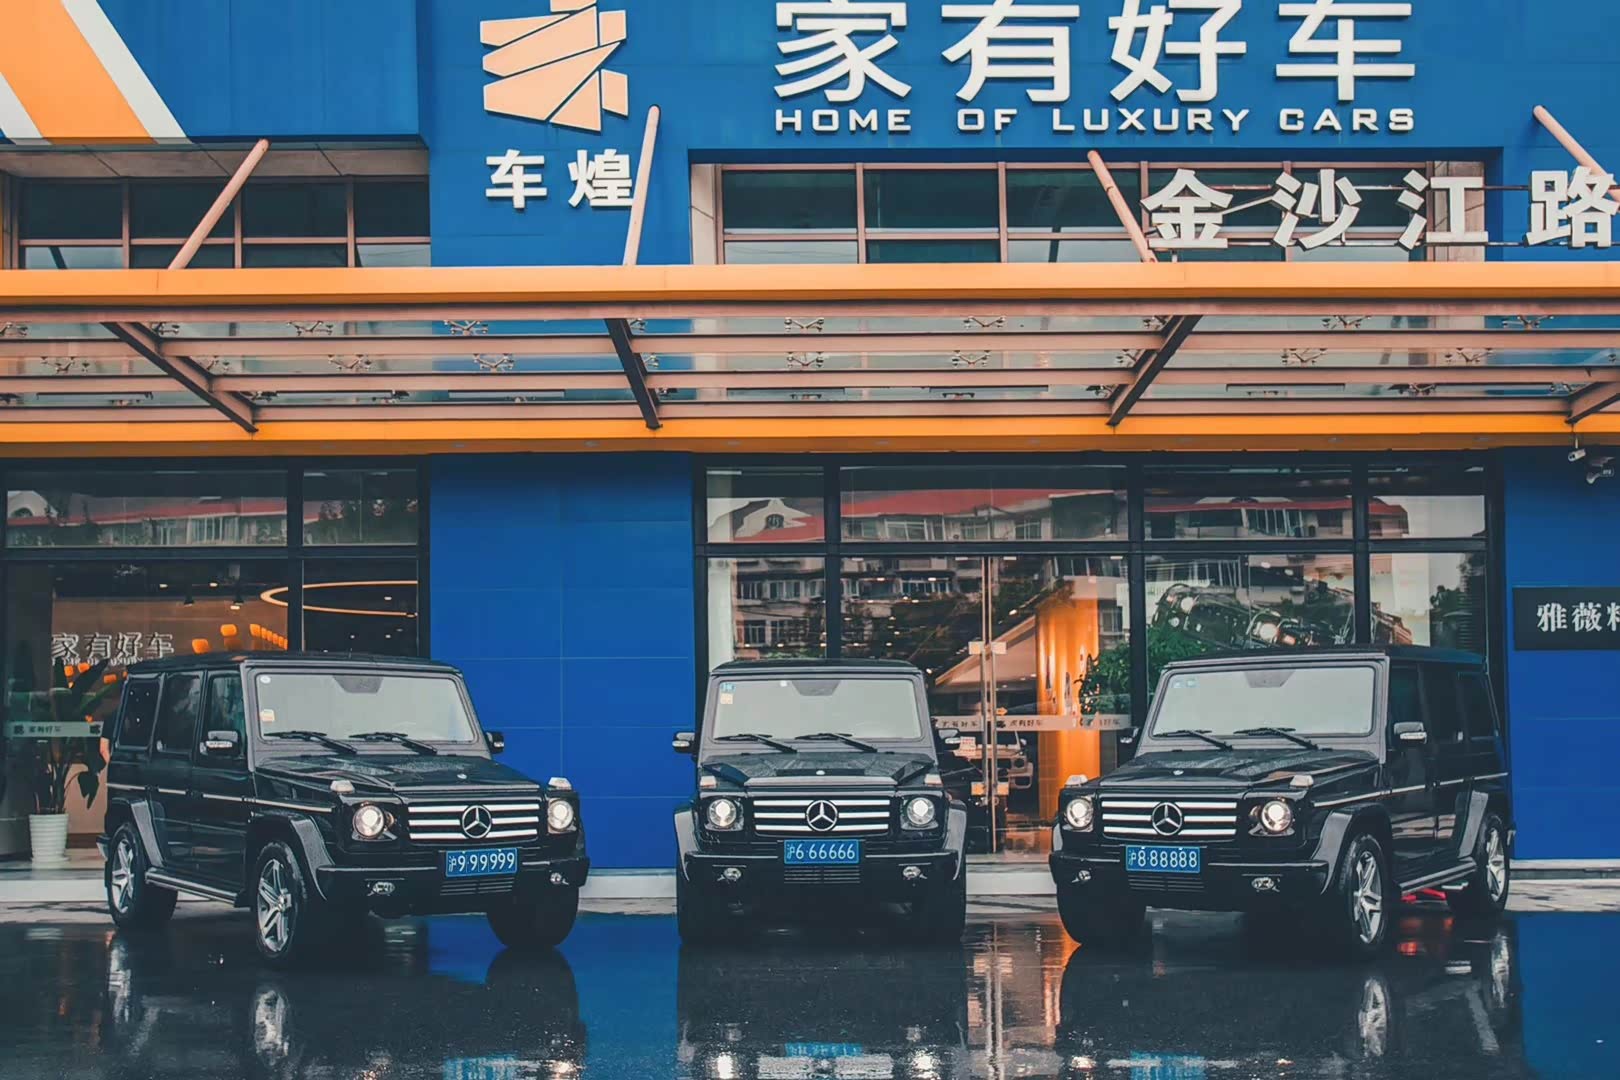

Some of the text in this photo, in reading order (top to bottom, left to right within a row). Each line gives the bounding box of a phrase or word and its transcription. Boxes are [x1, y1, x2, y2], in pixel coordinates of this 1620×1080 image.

[773, 0, 1415, 102] 家有好车
[775, 108, 1414, 131] HOME OF LUXURY CARS
[485, 149, 635, 208] 车煌
[1140, 165, 1620, 250] 金沙江路
[51, 632, 174, 660] 家有好车
